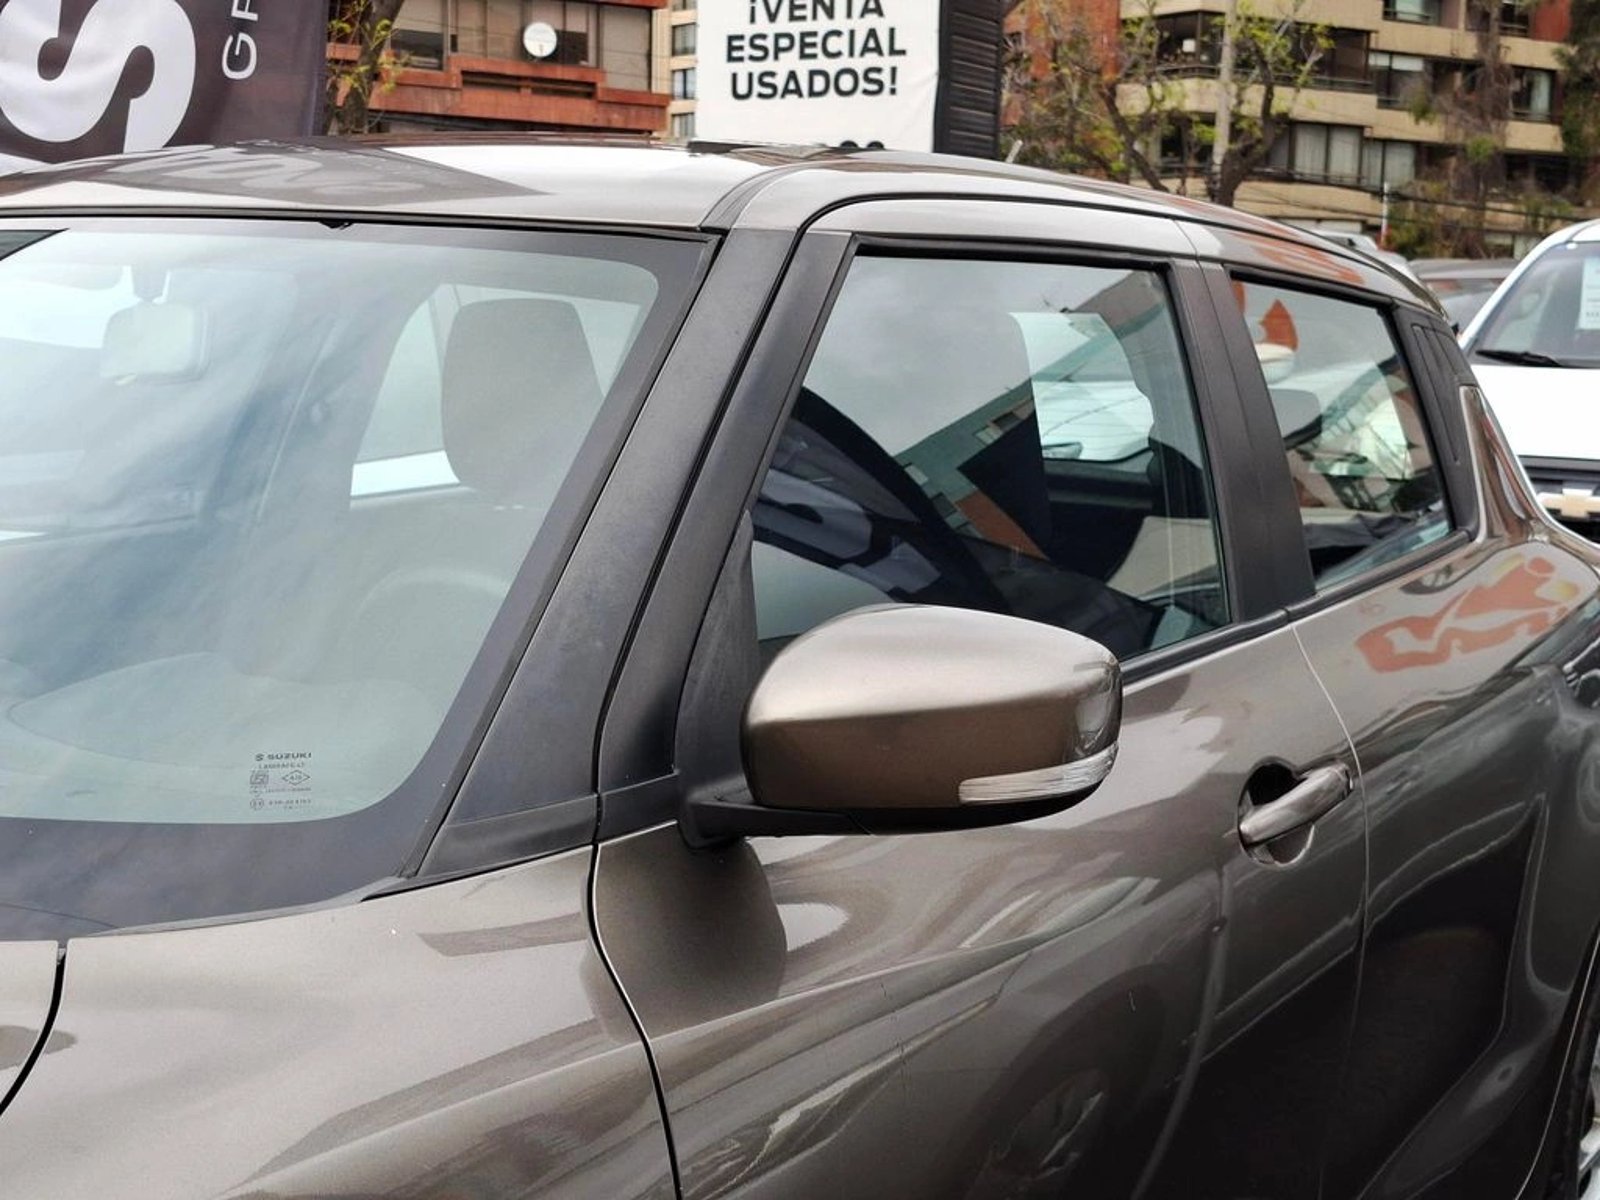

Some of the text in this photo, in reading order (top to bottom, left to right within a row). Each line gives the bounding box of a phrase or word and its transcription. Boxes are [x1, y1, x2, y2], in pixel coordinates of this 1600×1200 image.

[726, 27, 907, 63] ESPECIAL
[731, 66, 898, 101] USADOS!
[267, 752, 312, 761] SUZUKI
